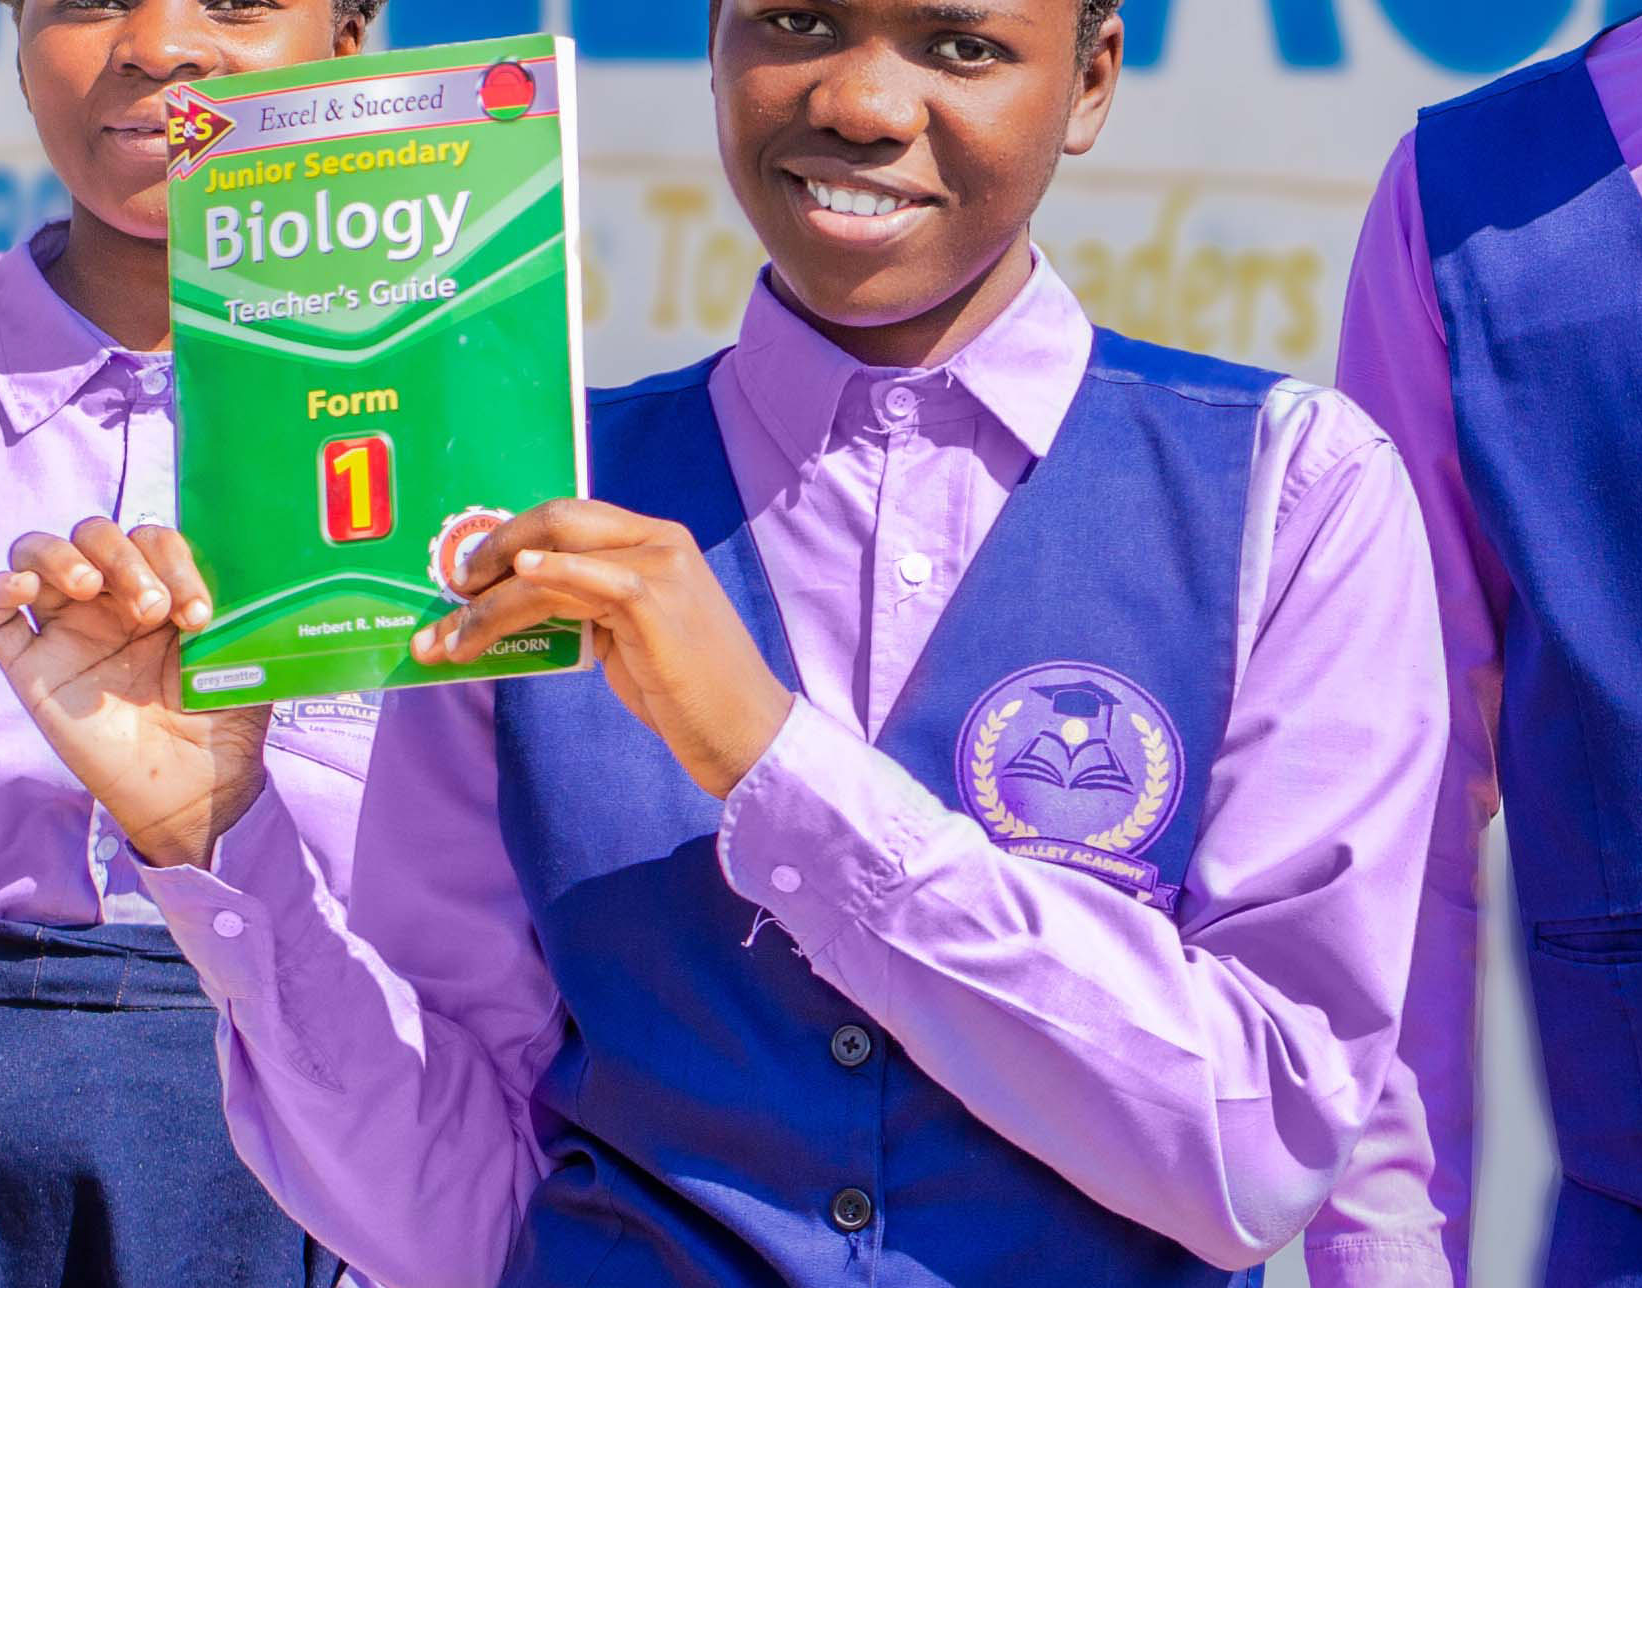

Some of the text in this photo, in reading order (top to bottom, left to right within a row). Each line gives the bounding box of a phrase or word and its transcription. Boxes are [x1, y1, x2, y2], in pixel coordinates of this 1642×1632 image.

[259, 84, 445, 133] Excel & Succeed
[168, 112, 214, 146] E&S
[204, 139, 470, 194] Junior Secondary
[205, 188, 471, 271] Biology
[225, 274, 457, 325] Teacher's Guide
[307, 385, 399, 421] Form
[332, 446, 371, 530] 1
[298, 614, 416, 638] Herbert R. Nsasa
[481, 637, 550, 656] NGHORN
[196, 669, 261, 690] grey matter
[304, 704, 380, 721] OAK VALLE
[1007, 845, 1069, 859] VALLEY
